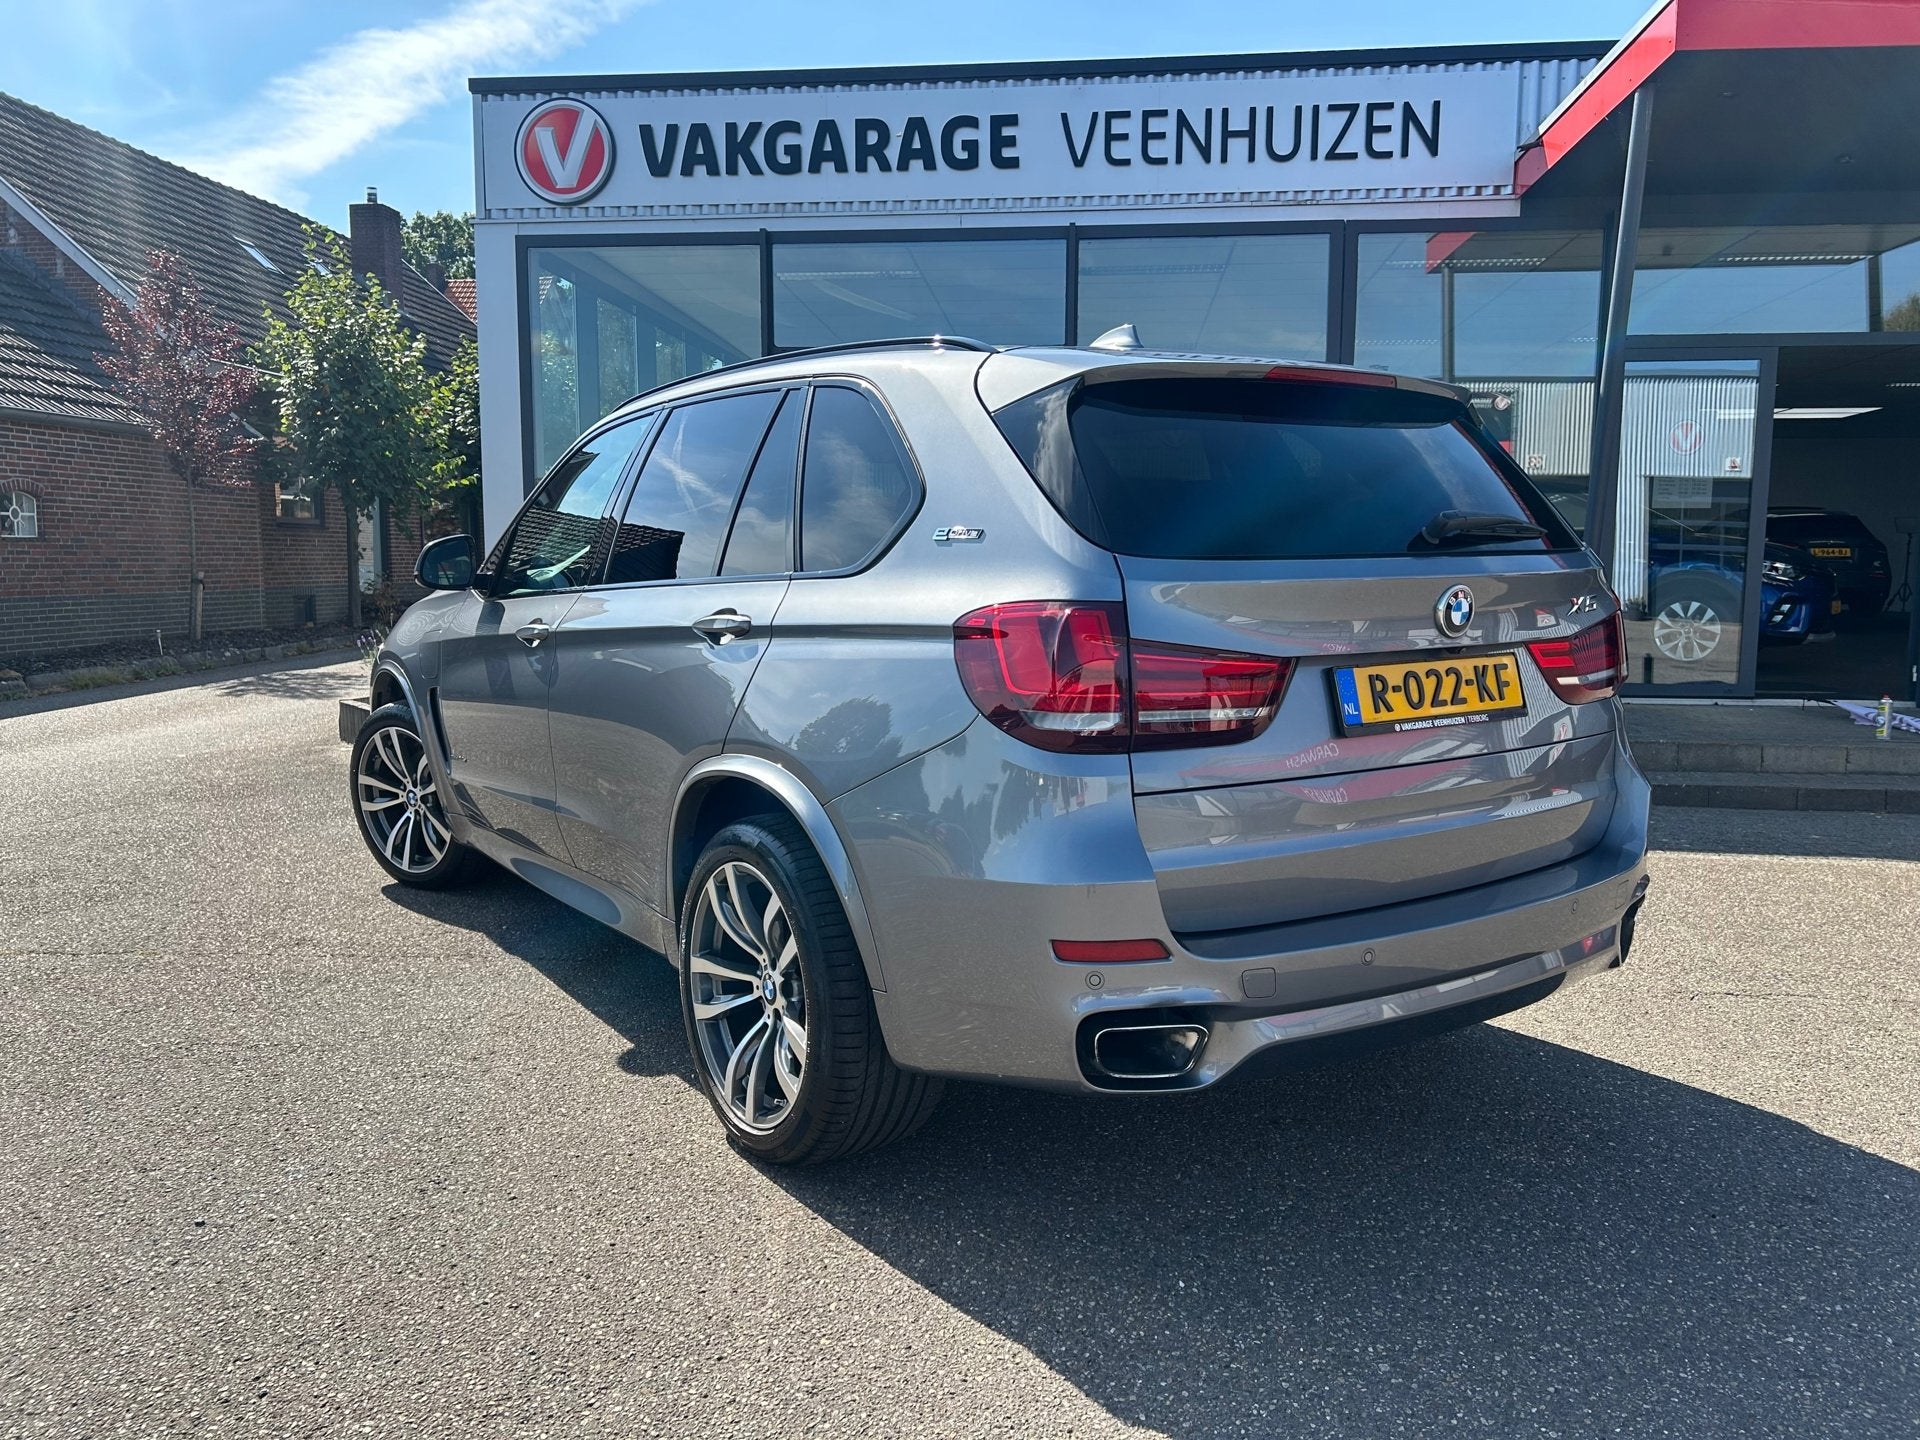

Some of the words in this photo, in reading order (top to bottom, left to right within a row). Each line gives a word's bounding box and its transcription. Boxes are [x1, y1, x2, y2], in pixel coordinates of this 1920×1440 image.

[638, 113, 1021, 178] VAKGARAGE
[1060, 99, 1442, 168] VEENHUIZEN
[1367, 662, 1511, 714] R-022-KF
[1344, 702, 1359, 716] NL
[1400, 720, 1434, 732] VAKGARAGE
[1434, 716, 1466, 728] VEENHUIZEN
[1468, 713, 1489, 724] TERBORG
